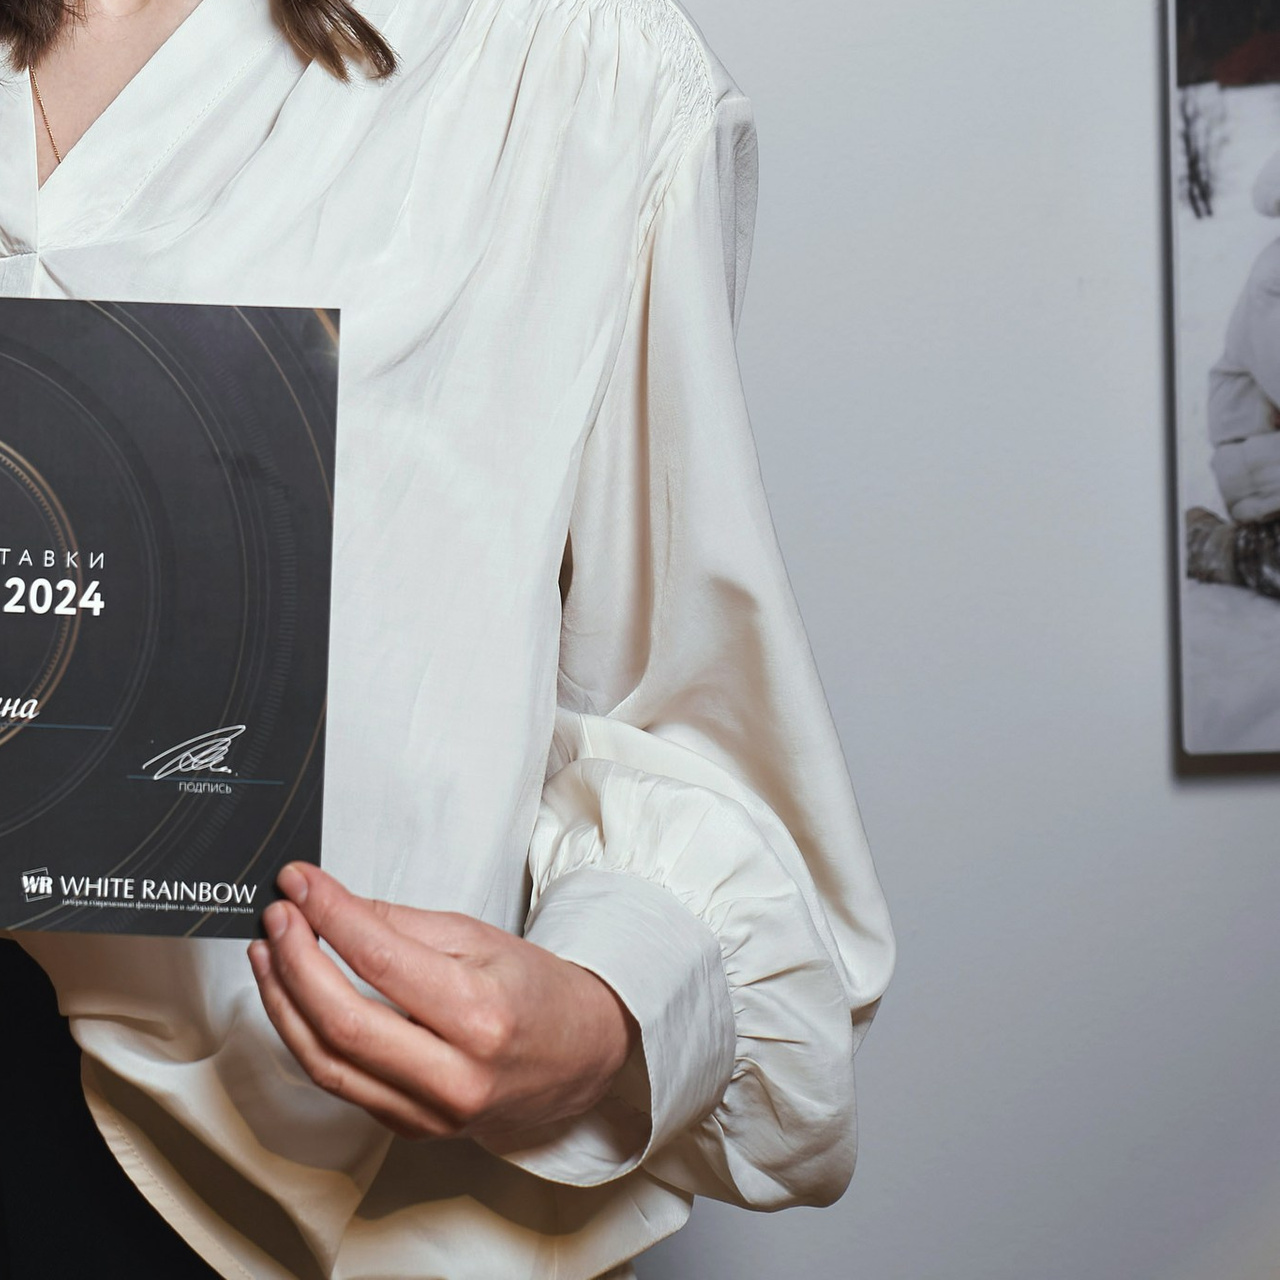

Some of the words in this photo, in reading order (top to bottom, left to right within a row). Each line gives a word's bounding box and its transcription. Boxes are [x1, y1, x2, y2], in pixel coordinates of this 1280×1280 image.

[2, 577, 105, 617] 2024
[60, 875, 135, 899] WHITE
[142, 879, 258, 904] RAINBOW
